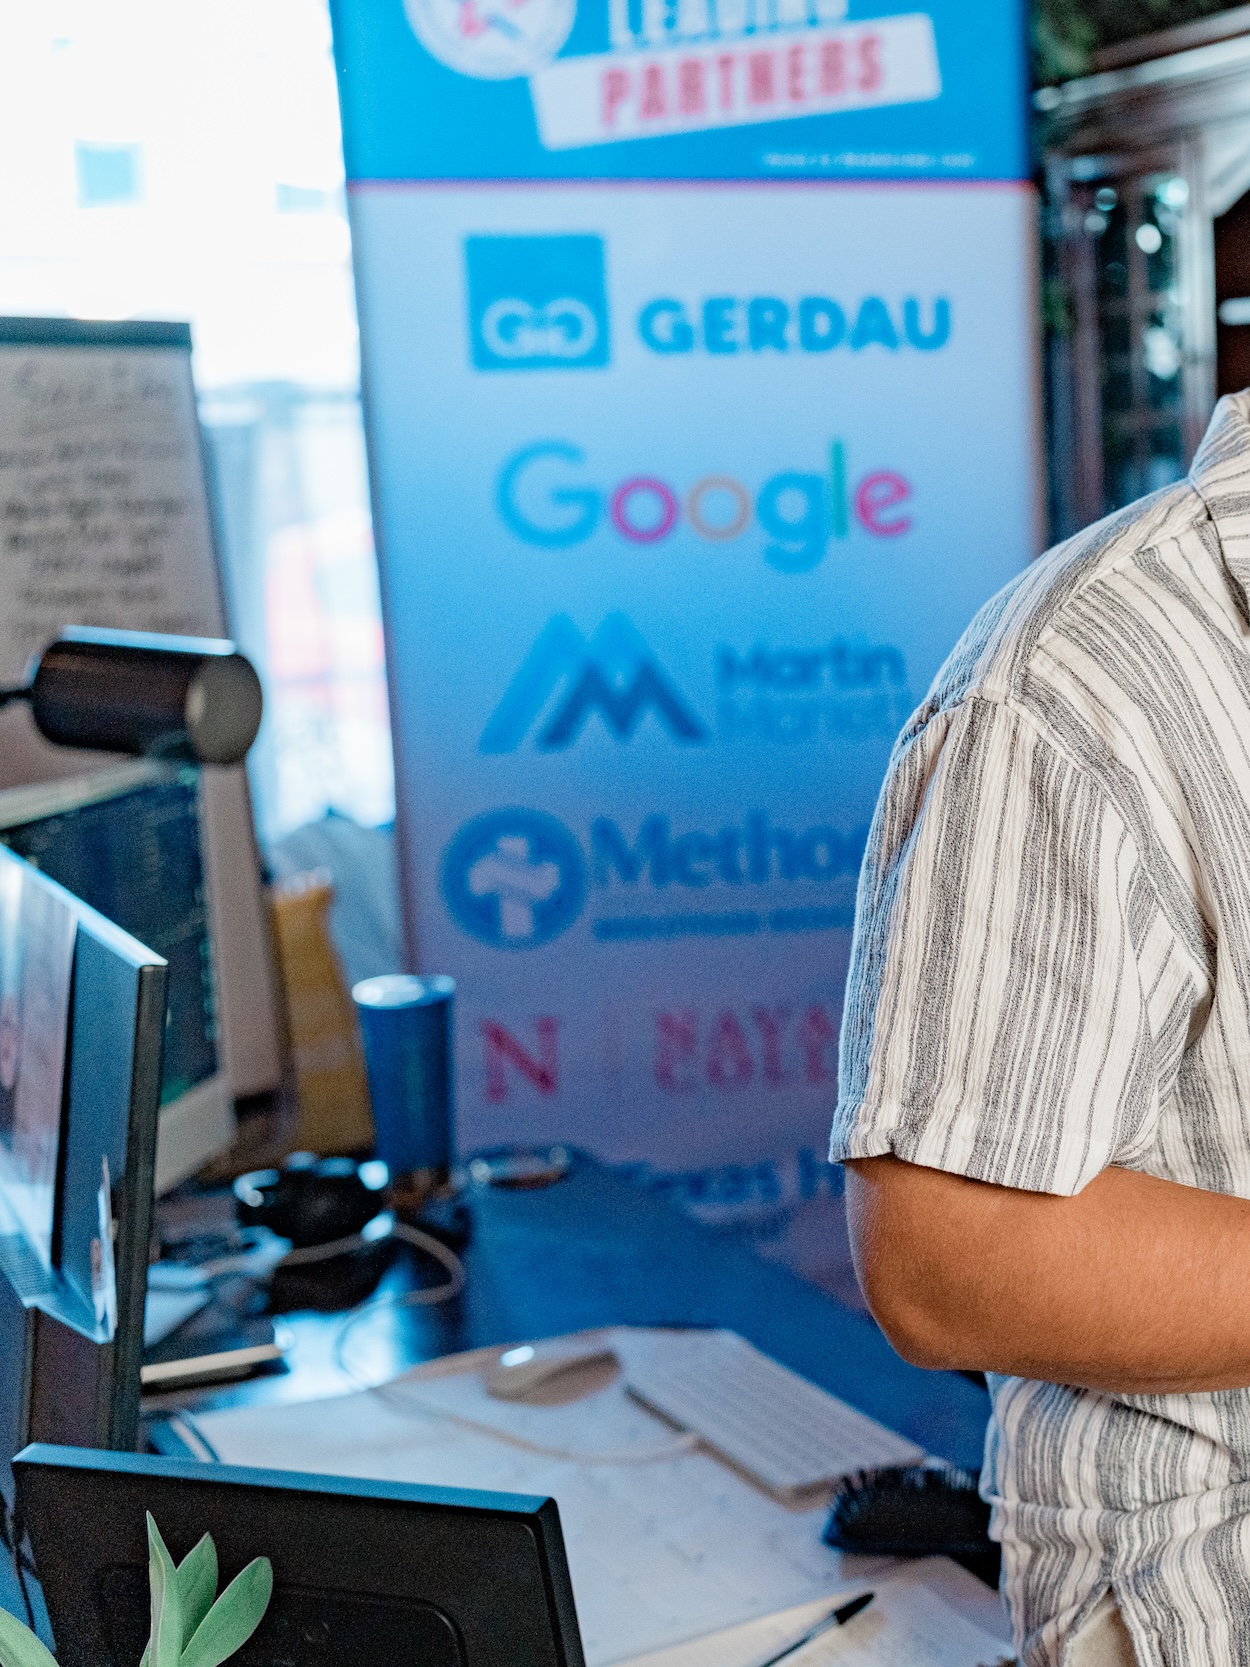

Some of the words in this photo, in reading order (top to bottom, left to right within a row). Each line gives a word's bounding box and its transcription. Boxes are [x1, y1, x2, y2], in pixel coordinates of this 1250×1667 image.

[602, 34, 881, 124] PARTNERS
[639, 297, 951, 353] GERDAU
[496, 437, 912, 573] Google
[716, 634, 905, 690] Martin
[481, 1017, 558, 1103] N
